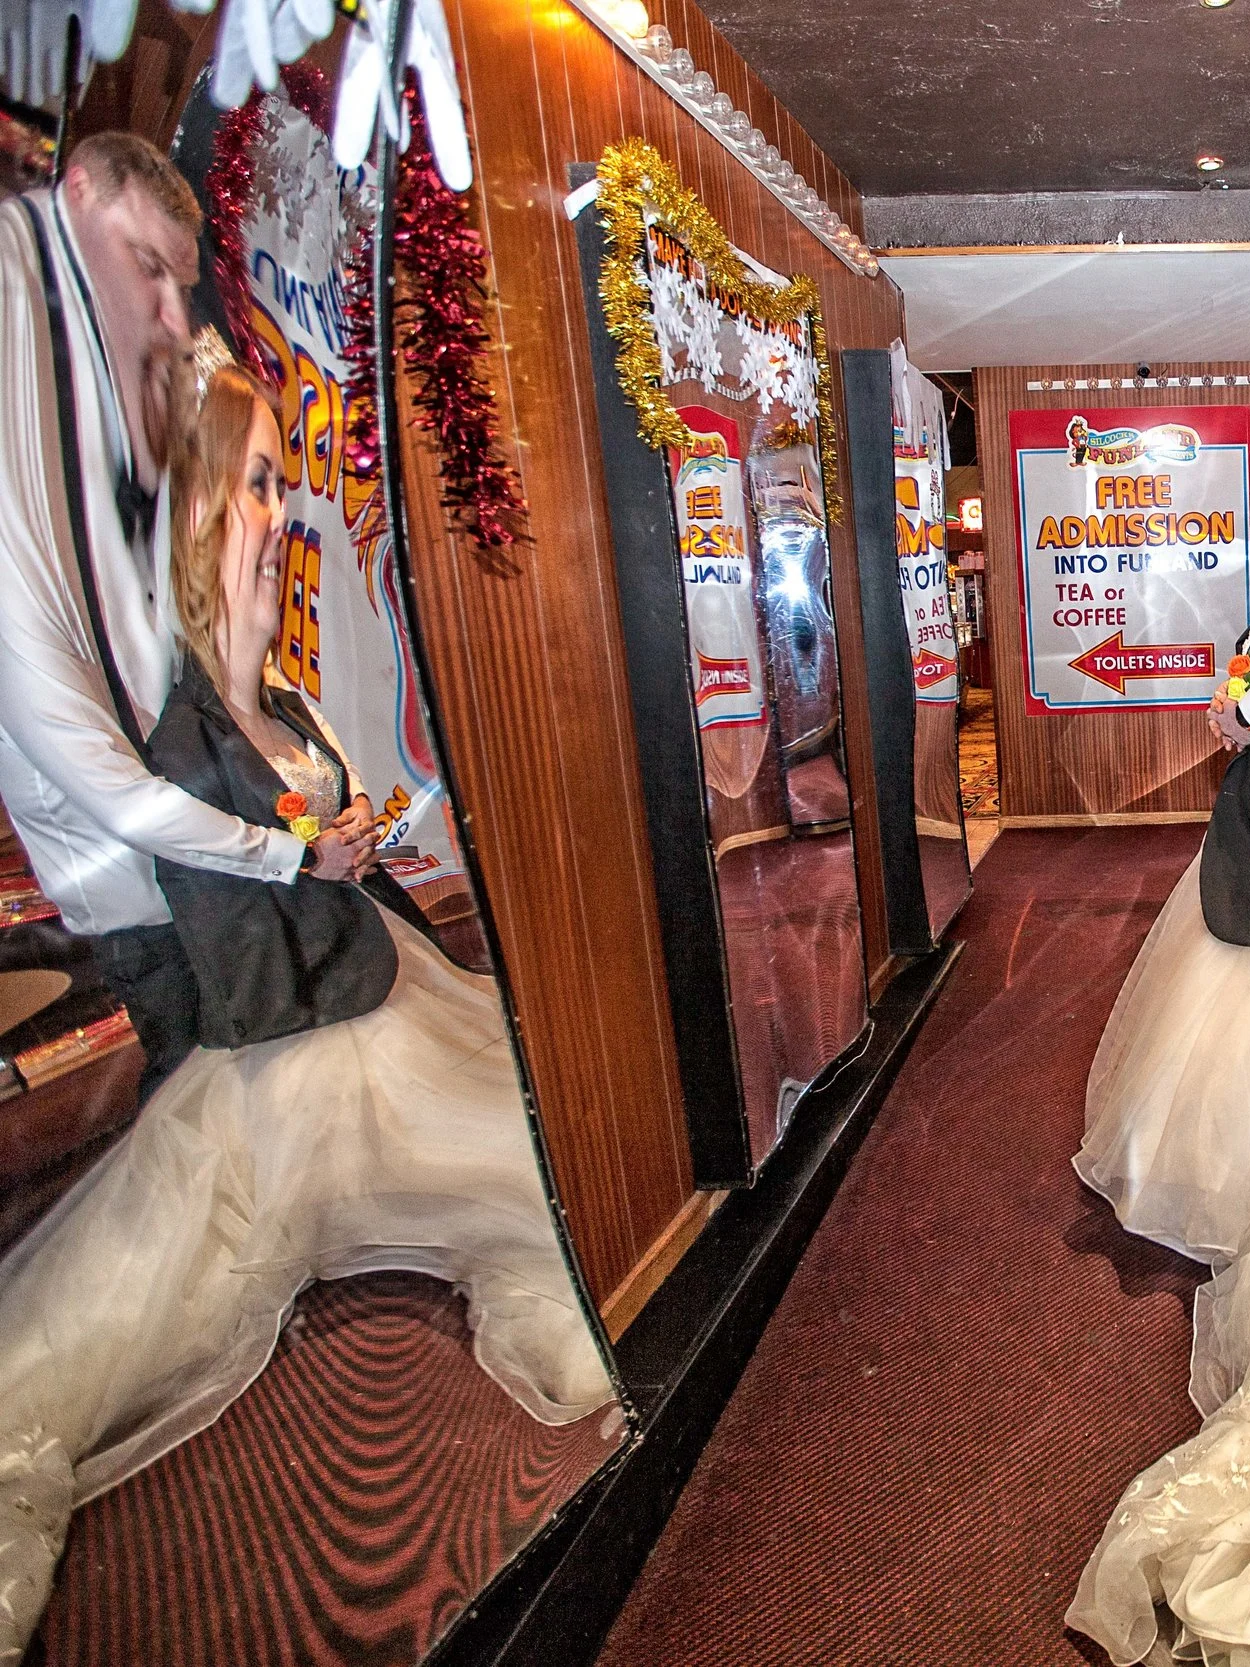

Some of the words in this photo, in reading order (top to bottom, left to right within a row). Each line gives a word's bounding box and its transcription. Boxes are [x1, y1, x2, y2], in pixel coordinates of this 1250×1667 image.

[1095, 475, 1172, 509] FREE
[1036, 511, 1235, 549] ADMISSION
[1055, 554, 1108, 574] INTO
[1055, 583, 1094, 601] TEA
[1104, 587, 1125, 600] or
[1053, 608, 1126, 627] COFFEE
[1094, 655, 1155, 671] TOILETS
